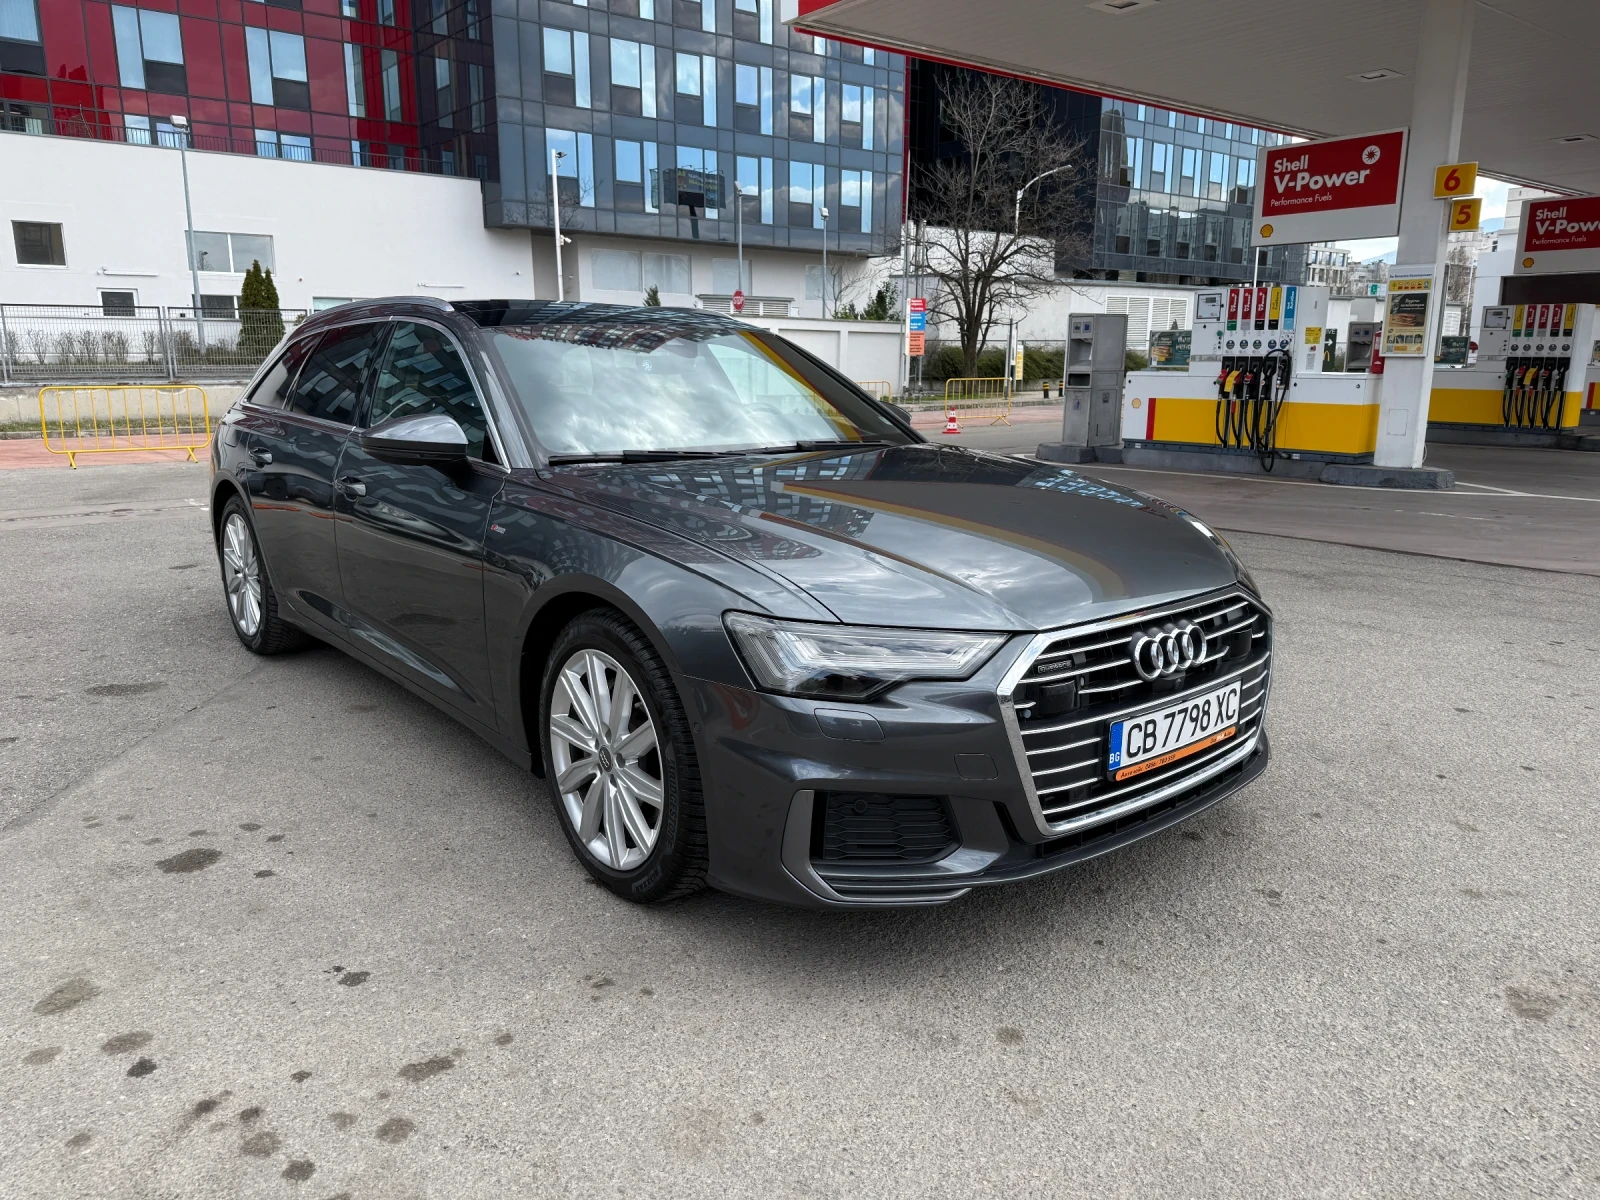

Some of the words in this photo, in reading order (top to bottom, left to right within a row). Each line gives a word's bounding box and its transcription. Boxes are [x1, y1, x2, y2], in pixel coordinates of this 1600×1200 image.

[1274, 154, 1309, 173] Shell
[1274, 169, 1370, 193] V-Power
[1444, 168, 1461, 192] 6
[1270, 197, 1313, 207] Performance
[1314, 192, 1332, 202] Fuels
[1456, 204, 1472, 225] 5
[1535, 206, 1567, 220] Shell
[1532, 237, 1569, 245] Performance
[1571, 234, 1587, 242] Fuels
[733, 296, 744, 305] STOP
[1126, 718, 1157, 758] CB
[1161, 699, 1211, 748] 7798
[1214, 688, 1237, 727] XC
[1109, 751, 1121, 764] BG
[665, 758, 679, 848] BRIDGESTONE
